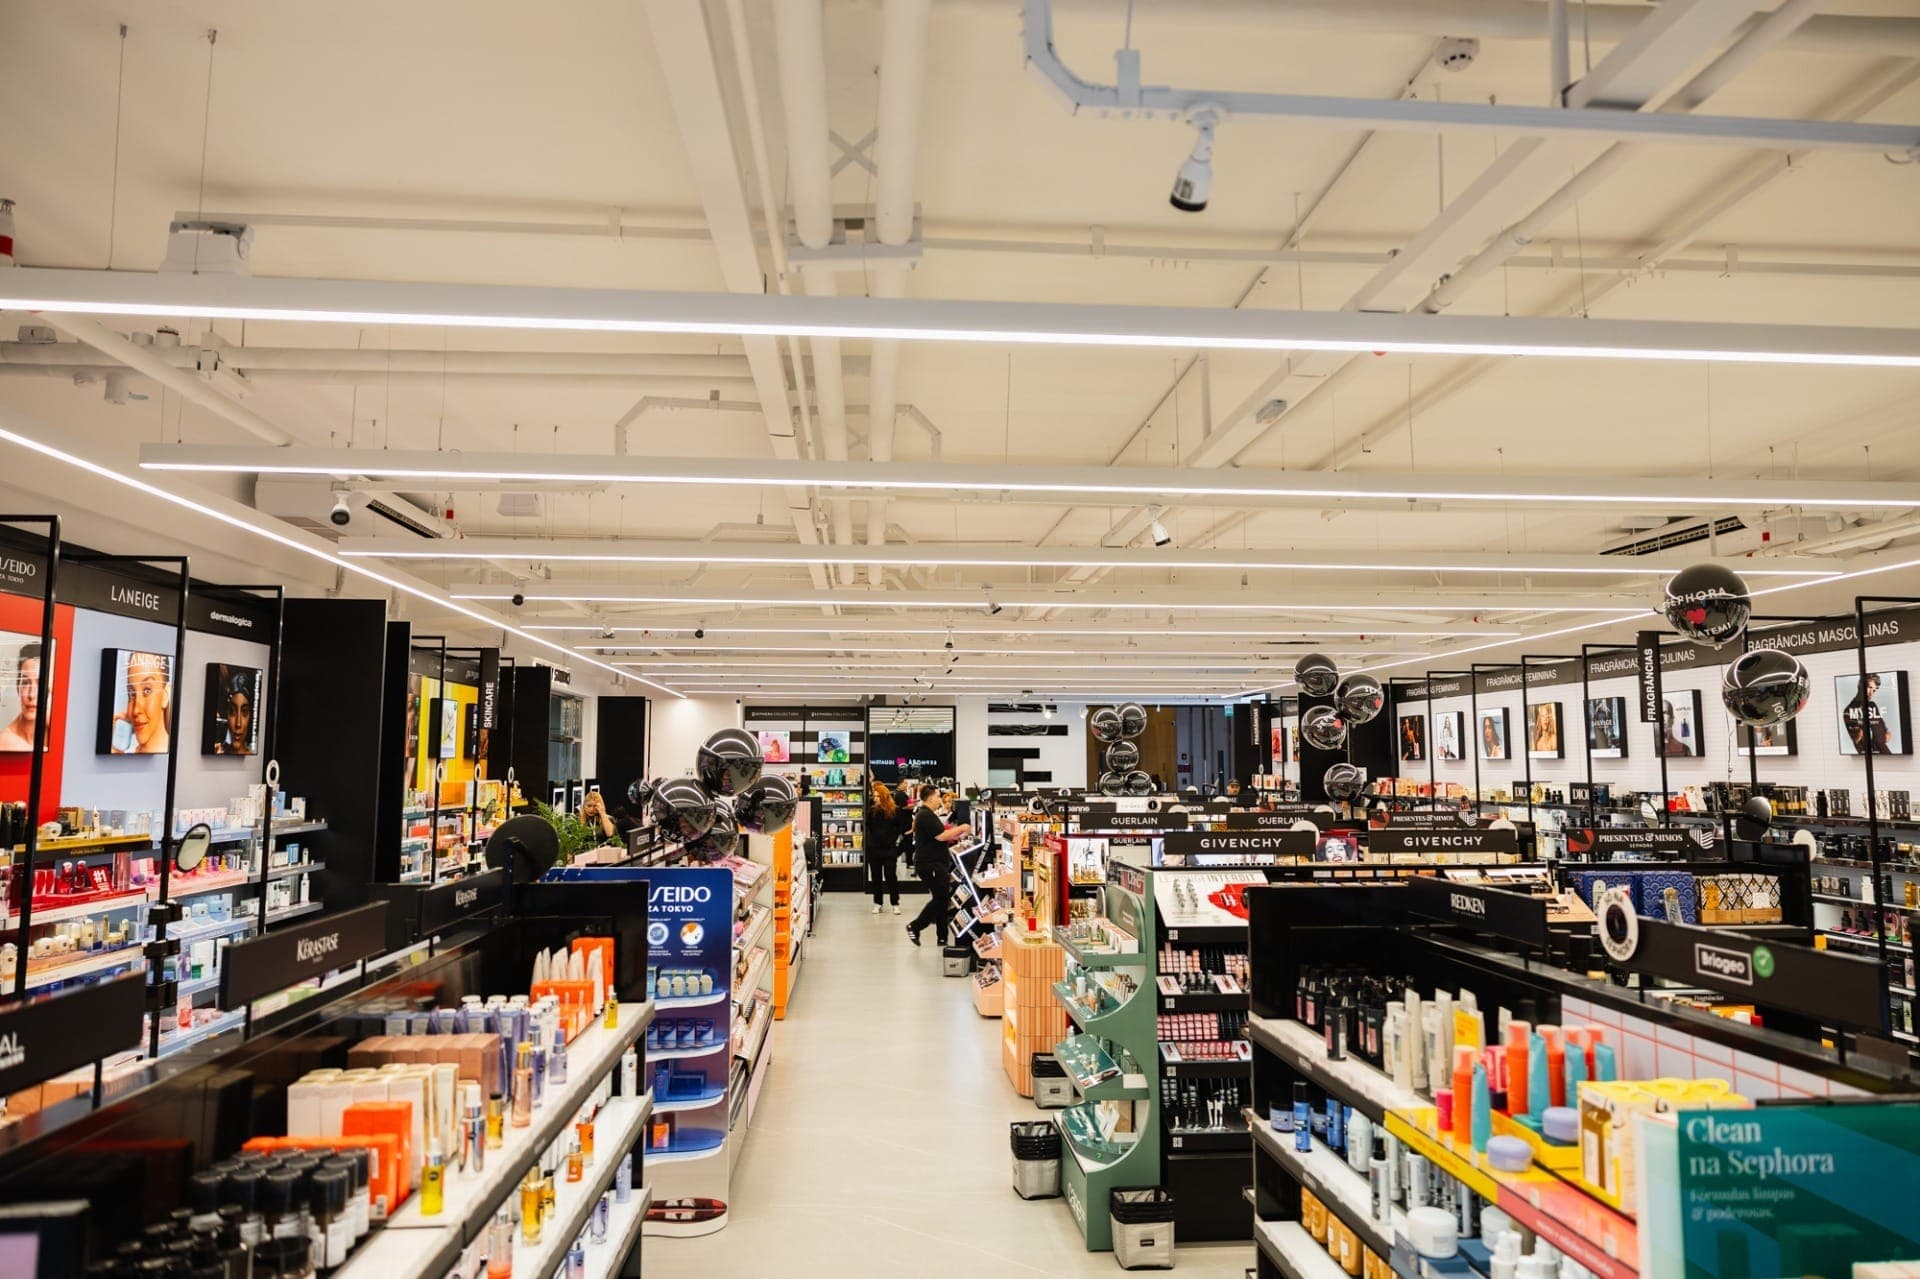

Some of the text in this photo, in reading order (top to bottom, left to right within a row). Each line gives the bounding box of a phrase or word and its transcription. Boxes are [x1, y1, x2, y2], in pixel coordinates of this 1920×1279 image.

[111, 585, 160, 611] LANEIGE
[210, 611, 253, 628] dermalogica
[1818, 620, 1899, 644] MASCUINAS
[1643, 648, 1657, 721] FRAGRÂNCIAS
[484, 682, 495, 729] SKINCARE
[1110, 816, 1158, 826] GUERLAIN
[1113, 836, 1147, 844] GUERLAIN
[1200, 837, 1283, 849] GIVENCHY
[1403, 835, 1484, 847] GIVENCHY
[1599, 834, 1644, 843] PRESENTES
[1655, 833, 1683, 842] MIMOS
[92, 869, 107, 884] #1
[661, 905, 694, 913] TOKYO
[1451, 893, 1485, 915] REDKEN
[296, 932, 340, 962] KÉRASTASE
[1687, 1115, 1762, 1144] Clean
[1690, 1147, 1834, 1180] na Sephora
